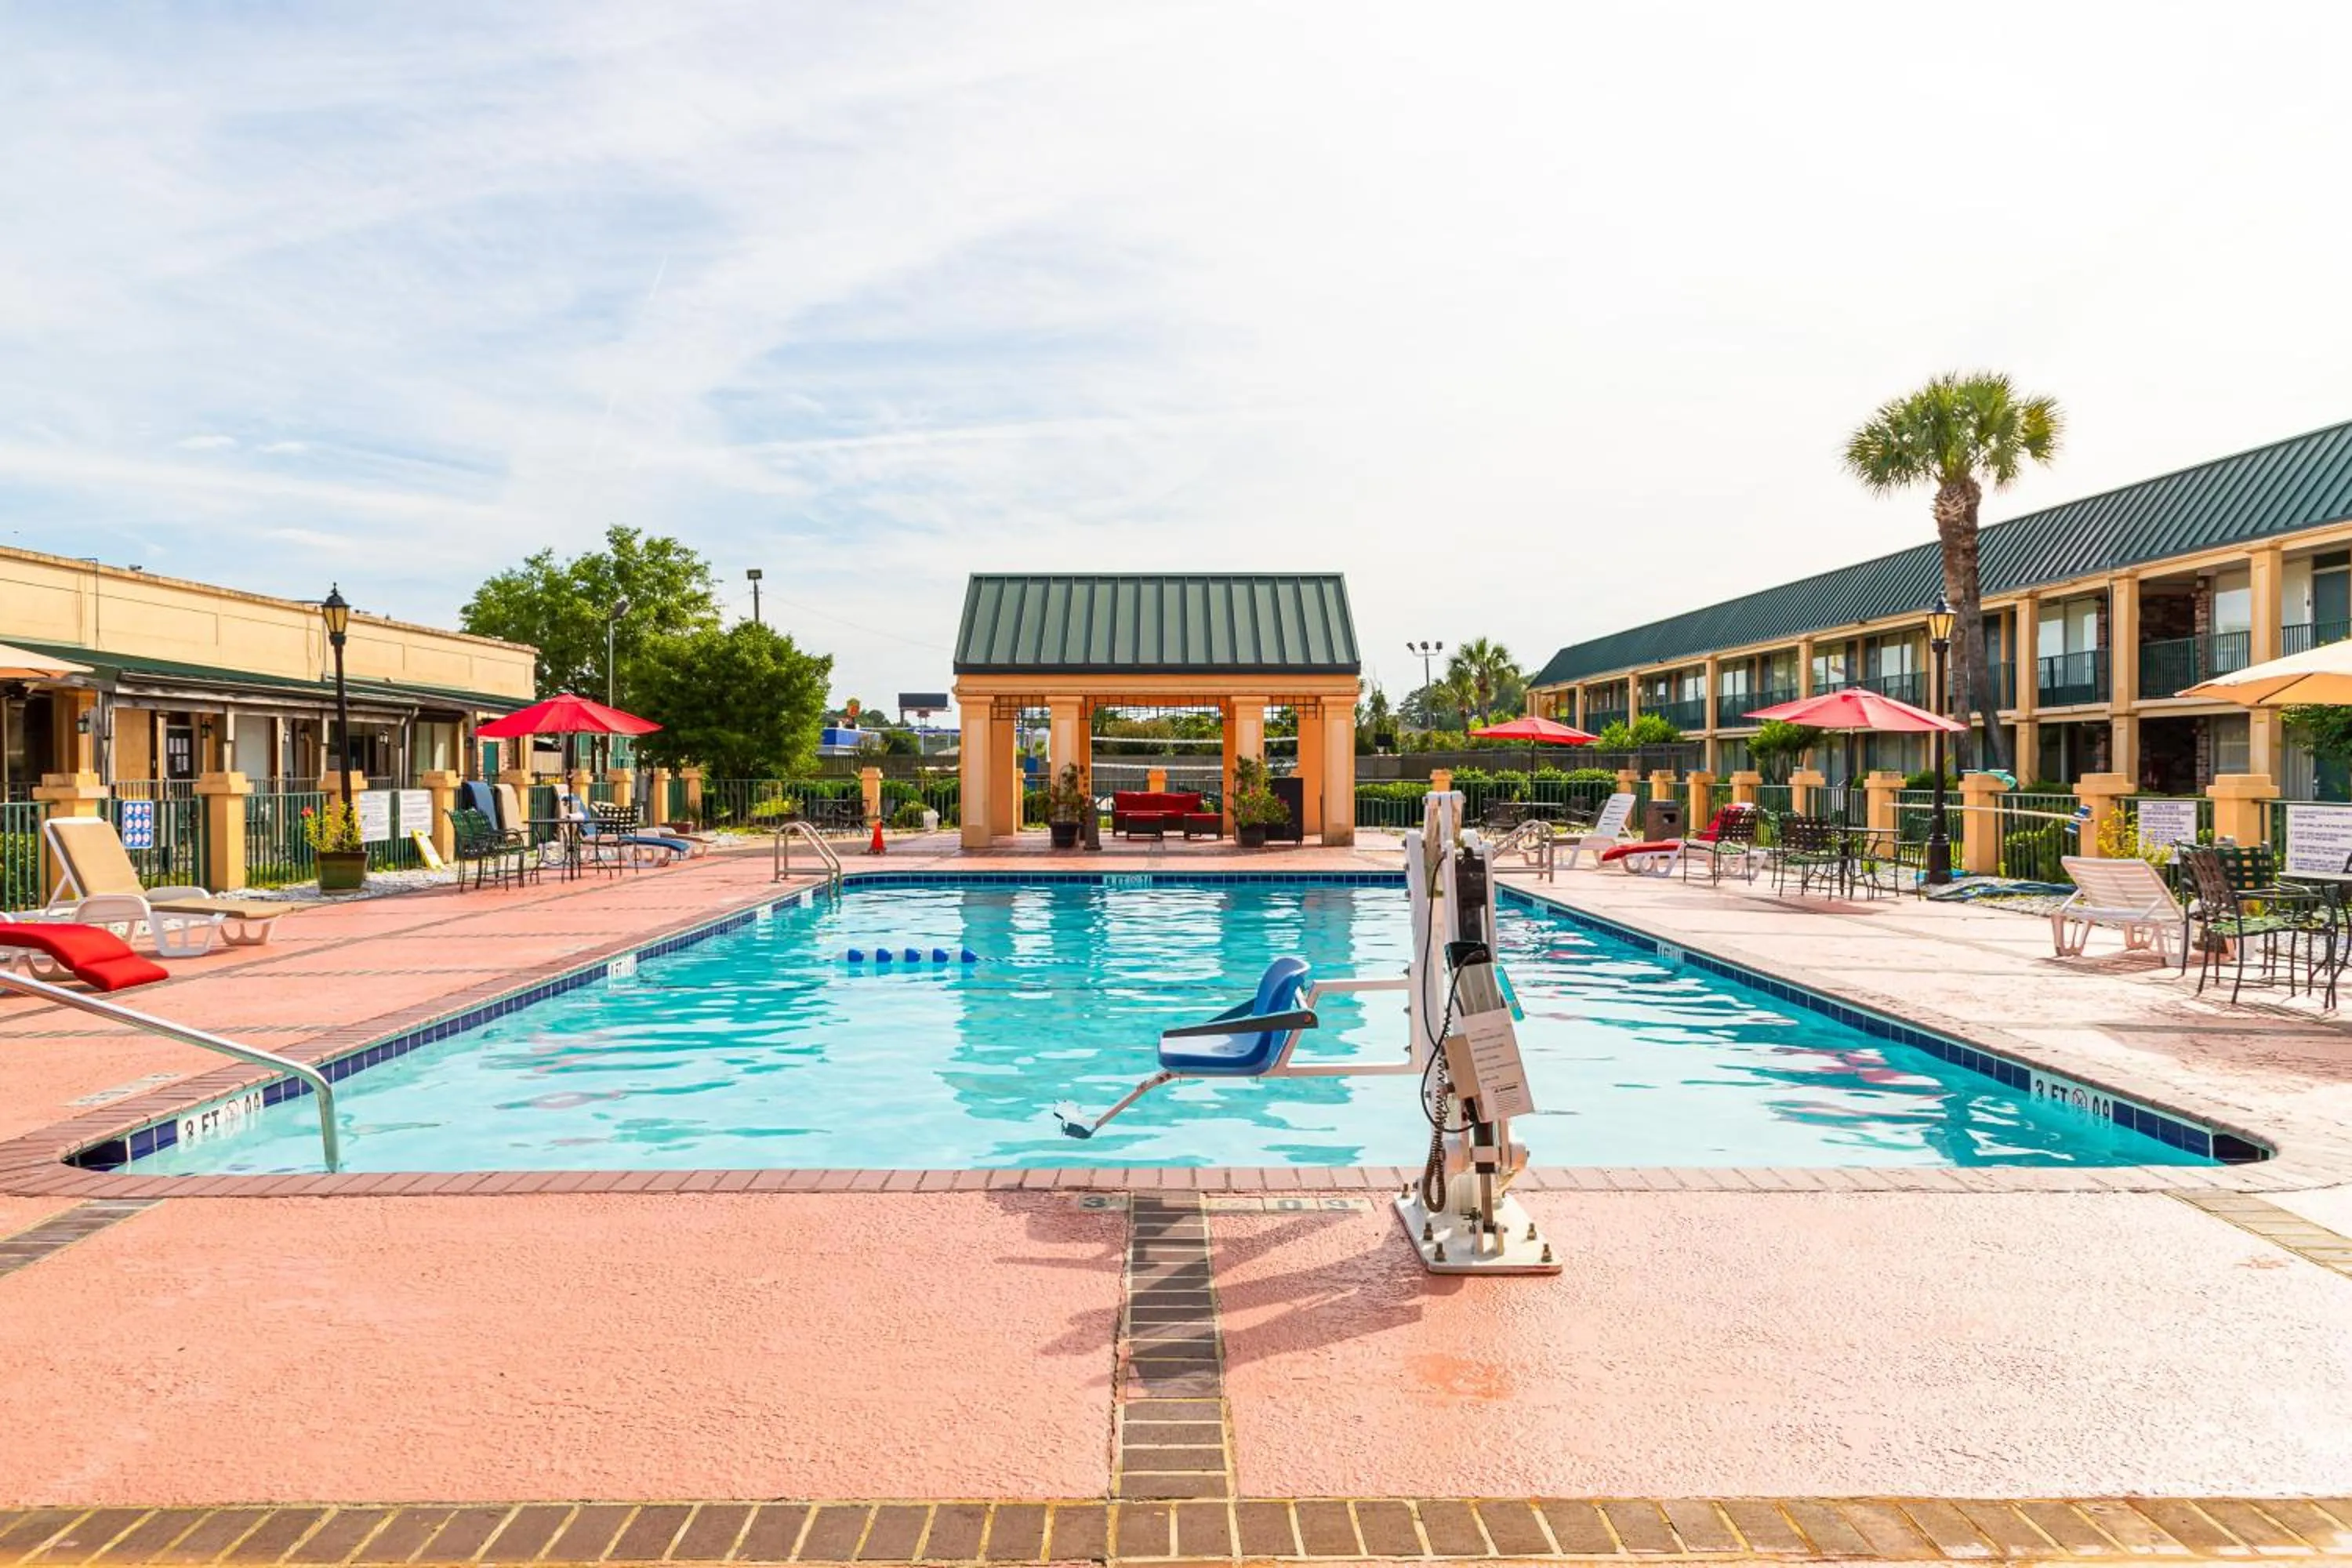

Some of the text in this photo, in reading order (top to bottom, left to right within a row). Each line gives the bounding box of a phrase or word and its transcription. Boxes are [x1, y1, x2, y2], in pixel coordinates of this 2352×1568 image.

[2052, 1084, 2067, 1102] FT
[201, 1109, 220, 1132] FT
[1083, 1196, 1105, 1208] 3
